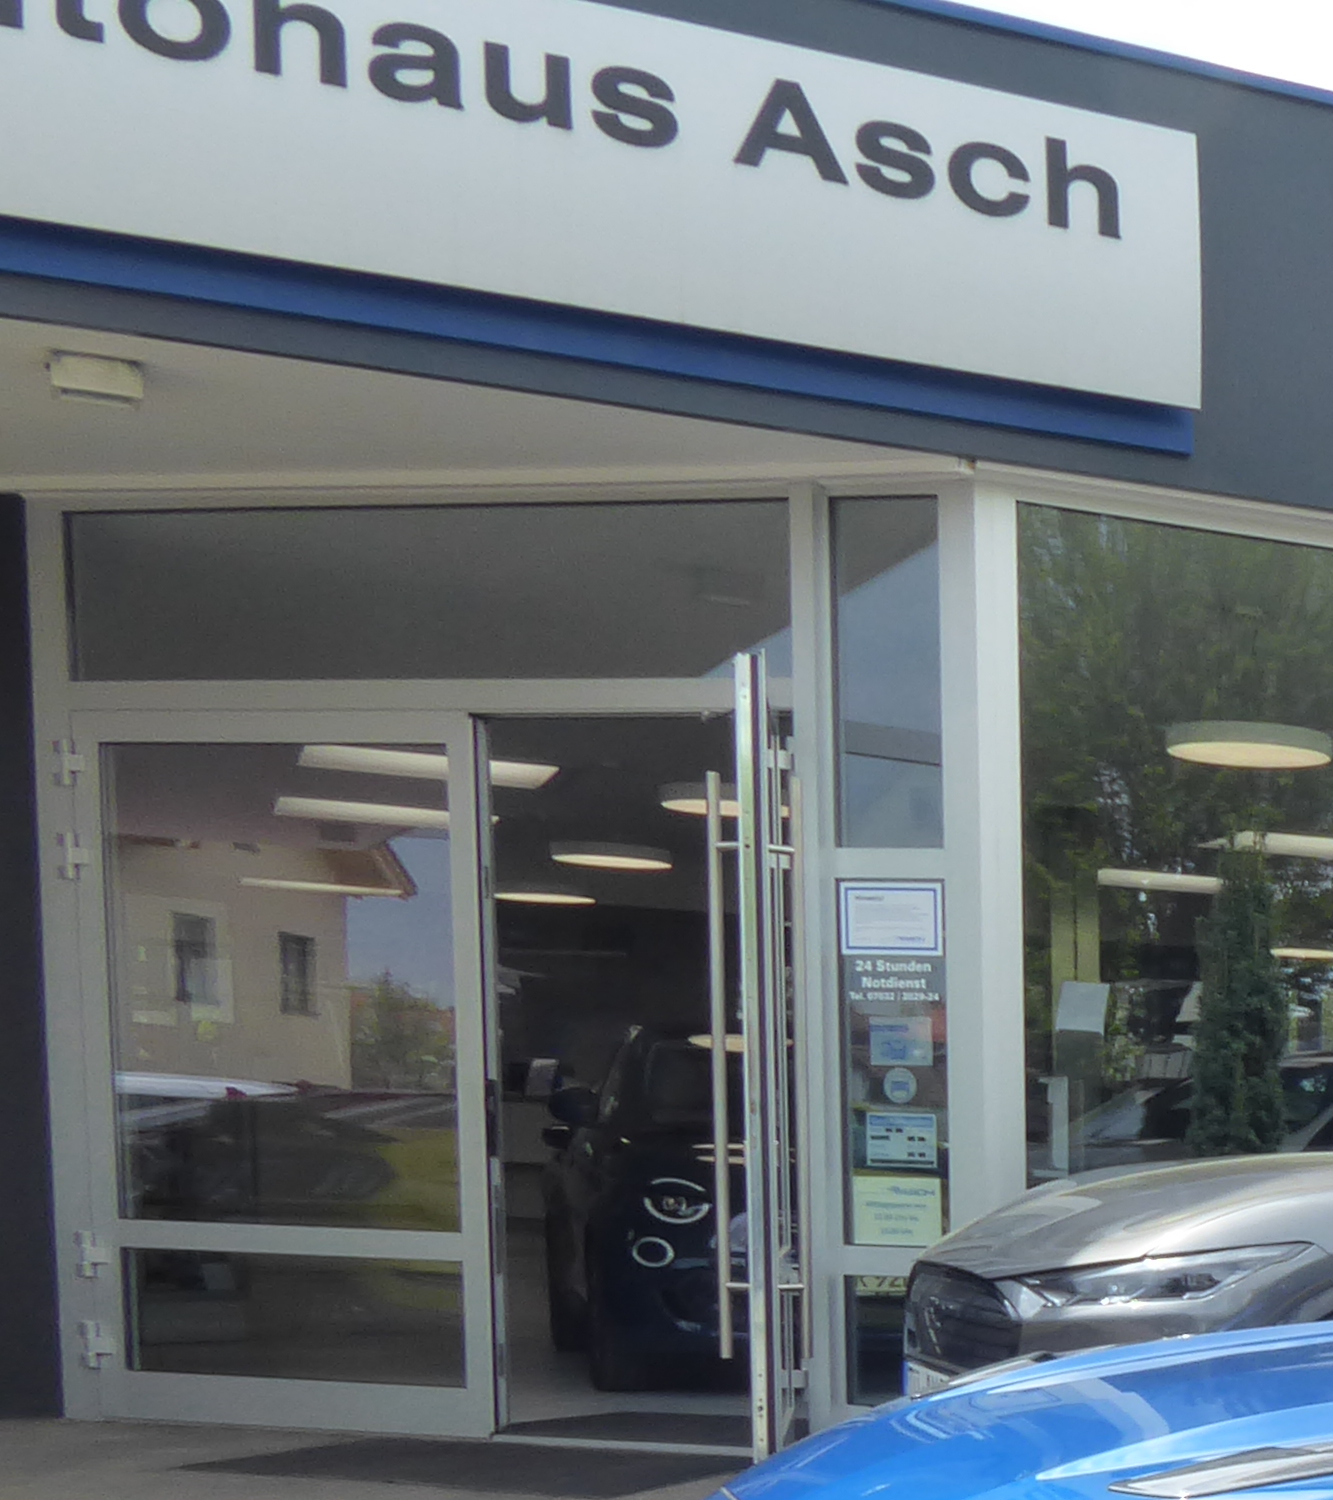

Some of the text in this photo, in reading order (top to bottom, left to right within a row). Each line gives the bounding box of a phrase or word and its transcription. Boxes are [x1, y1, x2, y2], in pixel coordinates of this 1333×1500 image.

[733, 78, 1121, 239] Asch
[855, 960, 932, 972] 24 Stunden
[861, 976, 927, 989] Notdienst
